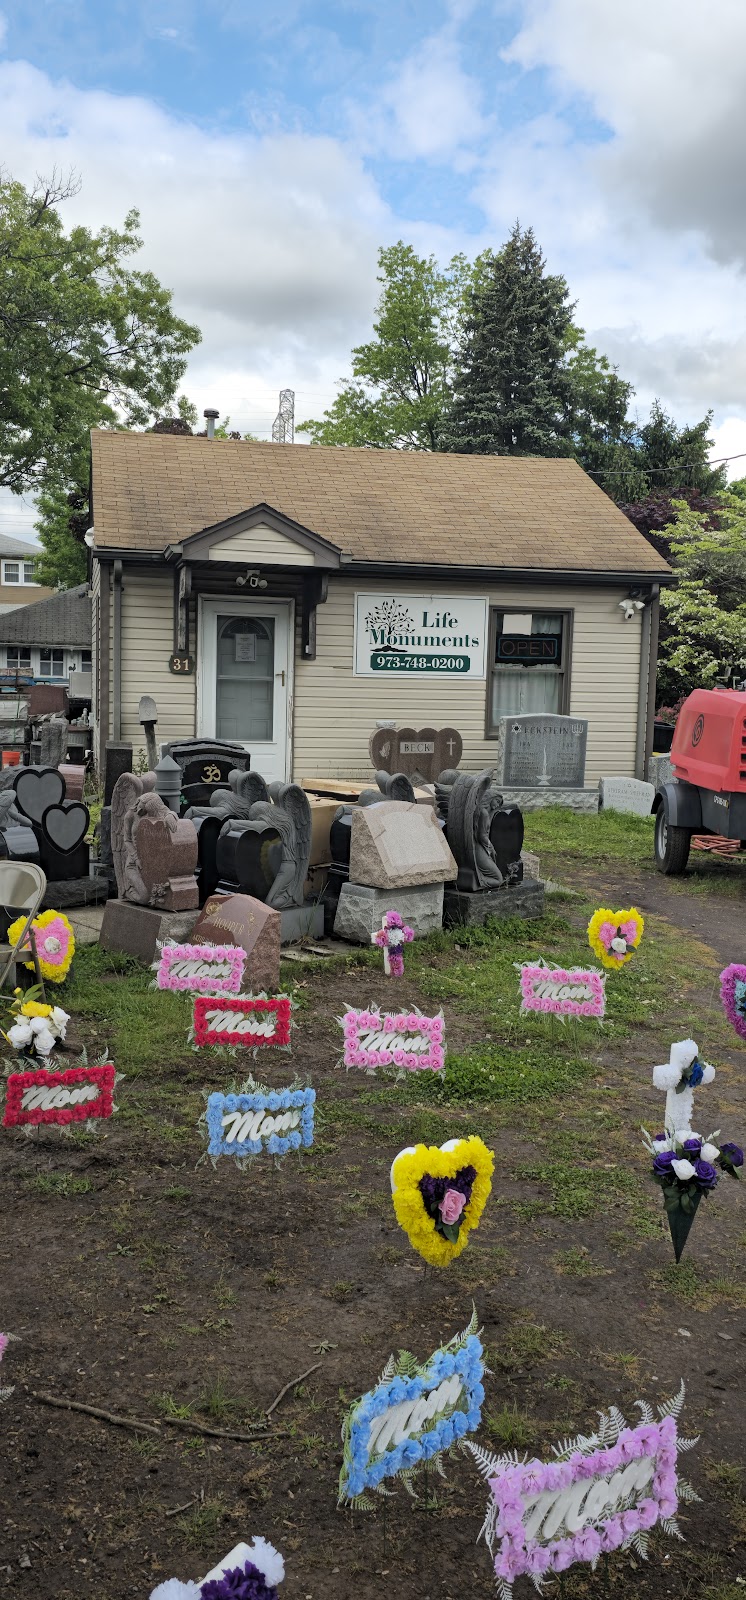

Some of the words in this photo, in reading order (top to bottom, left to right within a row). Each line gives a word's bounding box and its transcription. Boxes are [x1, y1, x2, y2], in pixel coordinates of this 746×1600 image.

[421, 611, 458, 628] Life
[369, 628, 480, 648] Monuments
[501, 640, 554, 656] OPEN
[173, 658, 189, 671] 31
[376, 656, 465, 670] 973-748-0200
[524, 726, 569, 735] ECKSTEIN
[404, 743, 430, 752] BECK
[170, 959, 233, 978] Mom
[532, 980, 594, 1000] Mom
[204, 1009, 276, 1038] Mom
[359, 1029, 431, 1052] Mom
[21, 1085, 99, 1111] Mom
[221, 1109, 301, 1144] Mom
